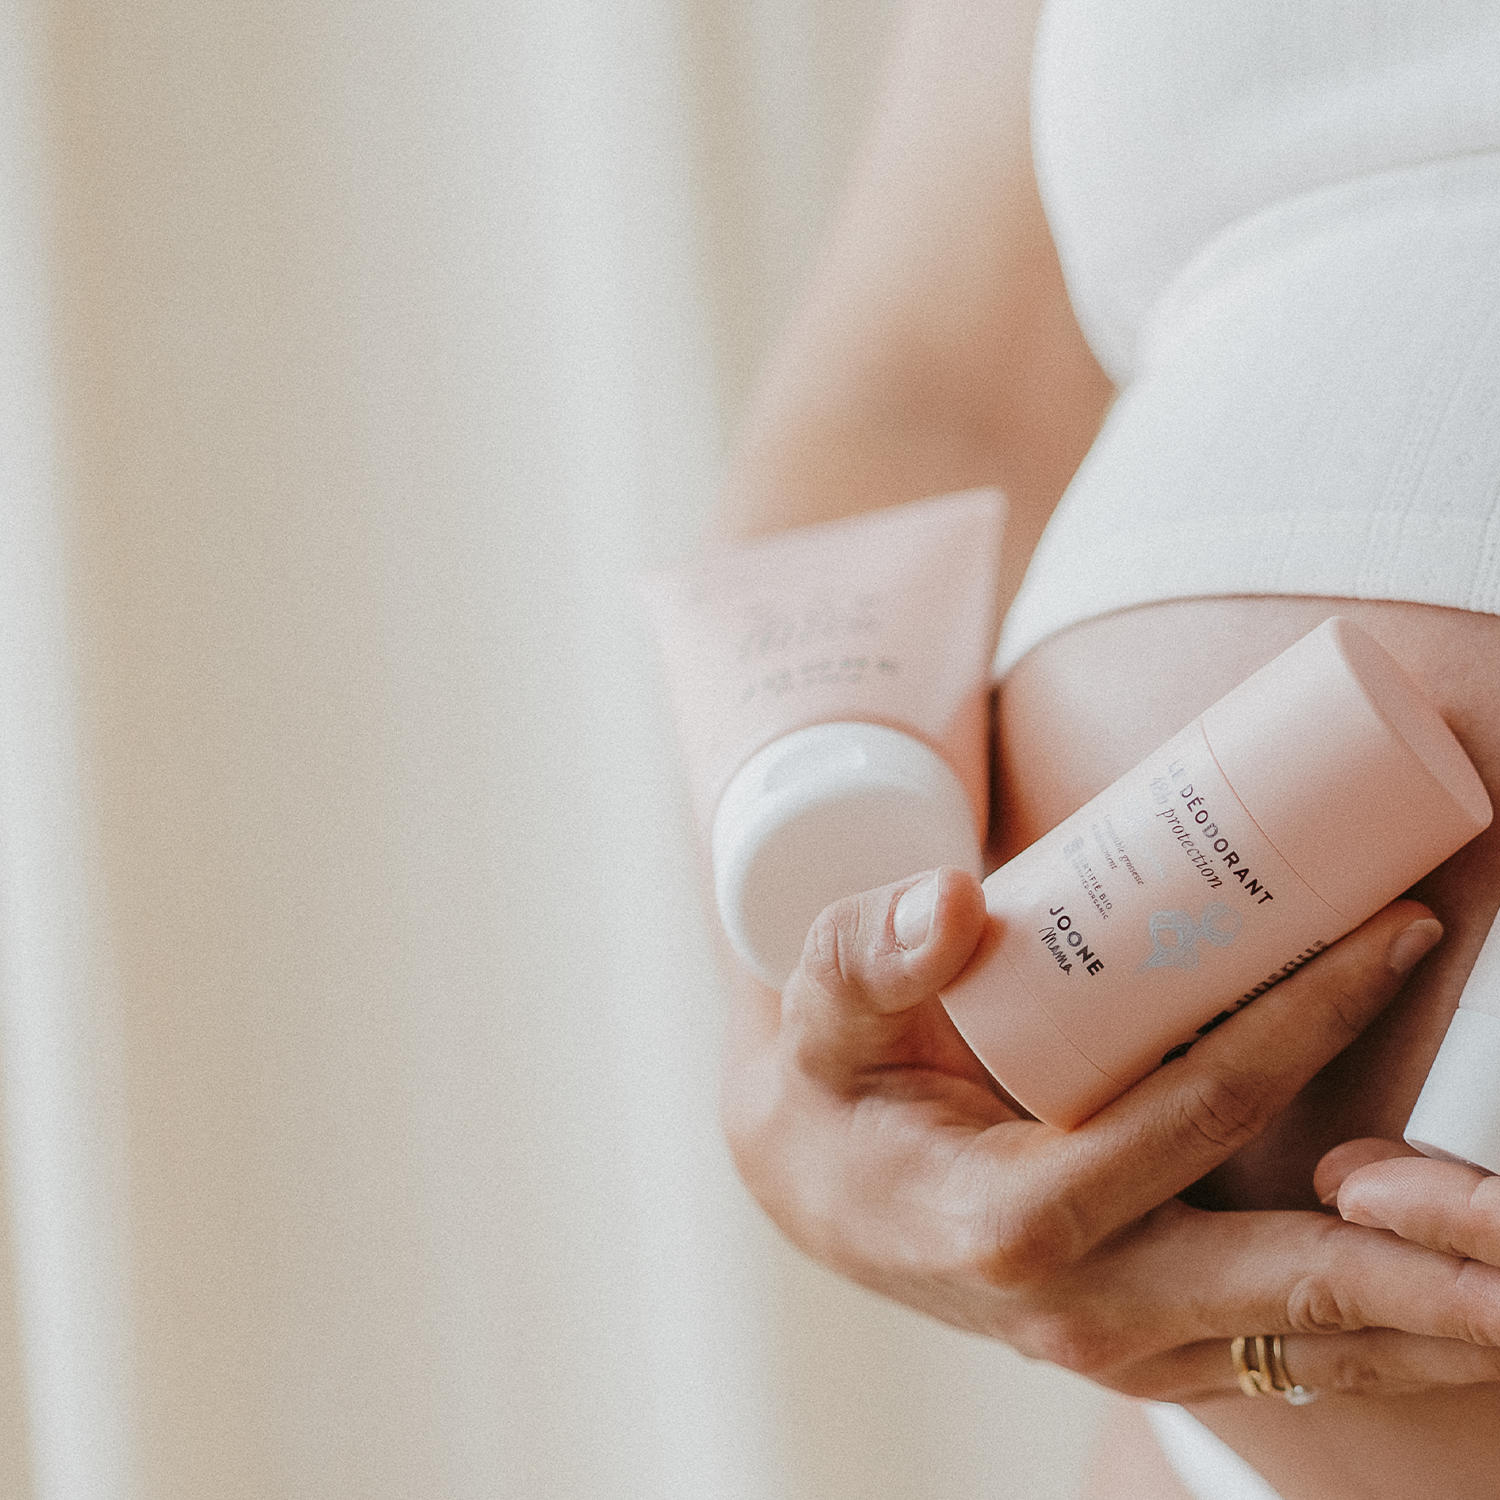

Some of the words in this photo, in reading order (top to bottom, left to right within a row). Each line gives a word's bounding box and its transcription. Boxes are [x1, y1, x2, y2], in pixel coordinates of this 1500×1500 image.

[1156, 807, 1223, 890] protection
[1180, 783, 1274, 905] DÉODORANT
[1119, 854, 1144, 885] grossesse
[1088, 890, 1109, 920] ORGANIC
[1099, 892, 1113, 910] BIO
[1049, 906, 1105, 976] JOONE
